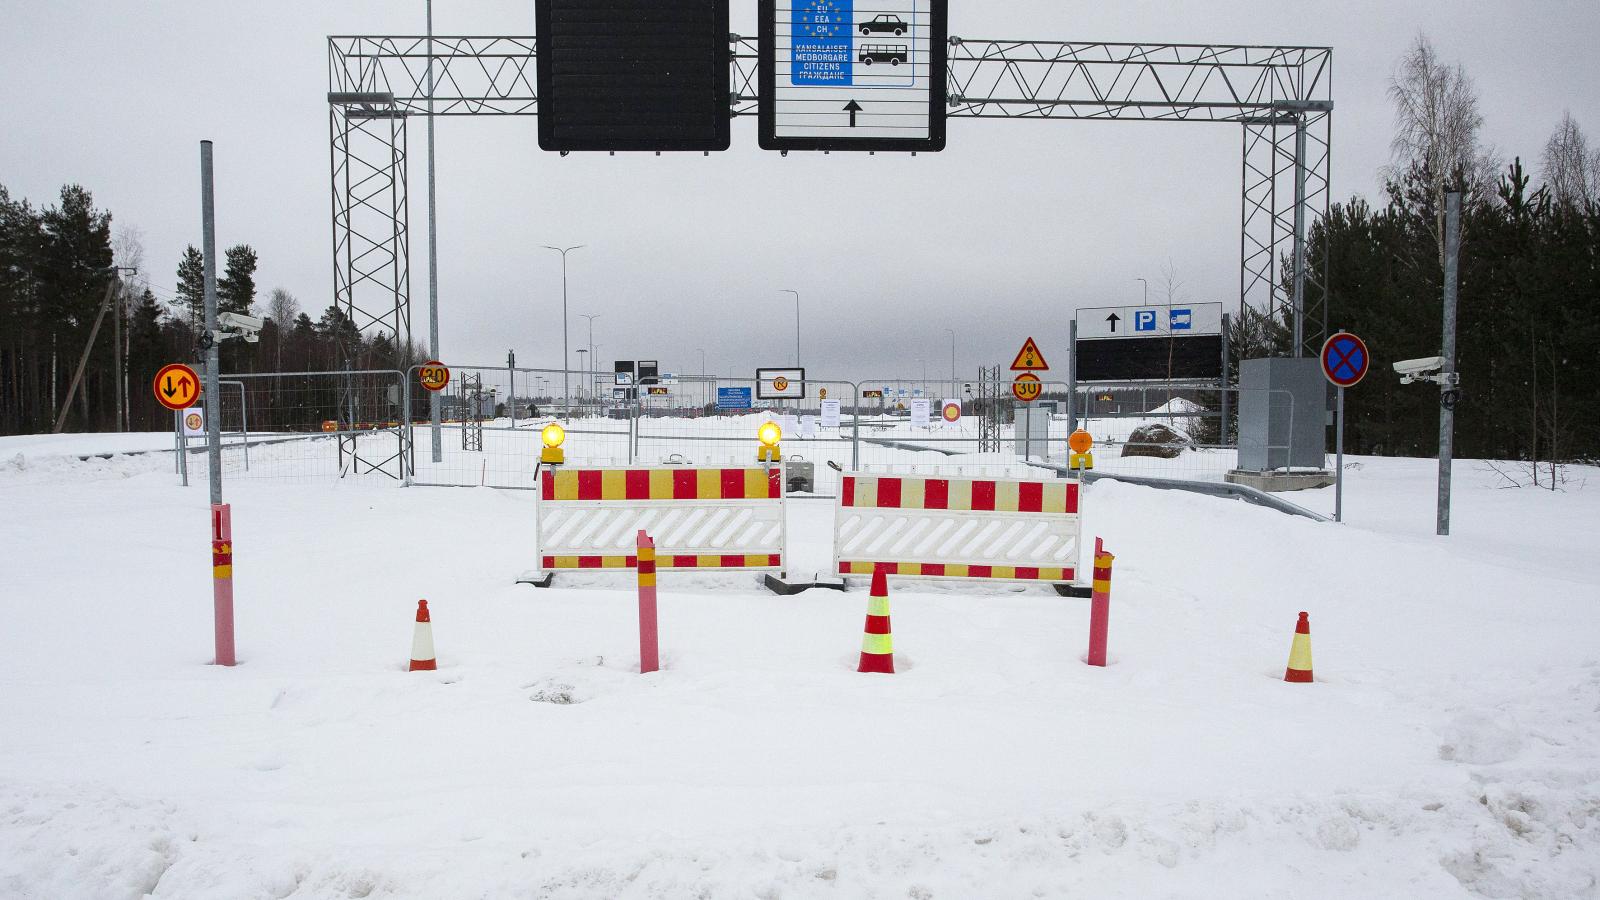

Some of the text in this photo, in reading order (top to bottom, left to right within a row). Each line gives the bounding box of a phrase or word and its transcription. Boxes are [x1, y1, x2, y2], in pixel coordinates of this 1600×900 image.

[817, 5, 828, 13] EU
[814, 15, 830, 23] EEA
[795, 45, 848, 53] KANSALAISET
[795, 53, 848, 61] MEDBORGARE
[799, 71, 844, 80] ГРАЖДАНЕ
[1139, 312, 1153, 330] P
[1018, 380, 1036, 395] 30
